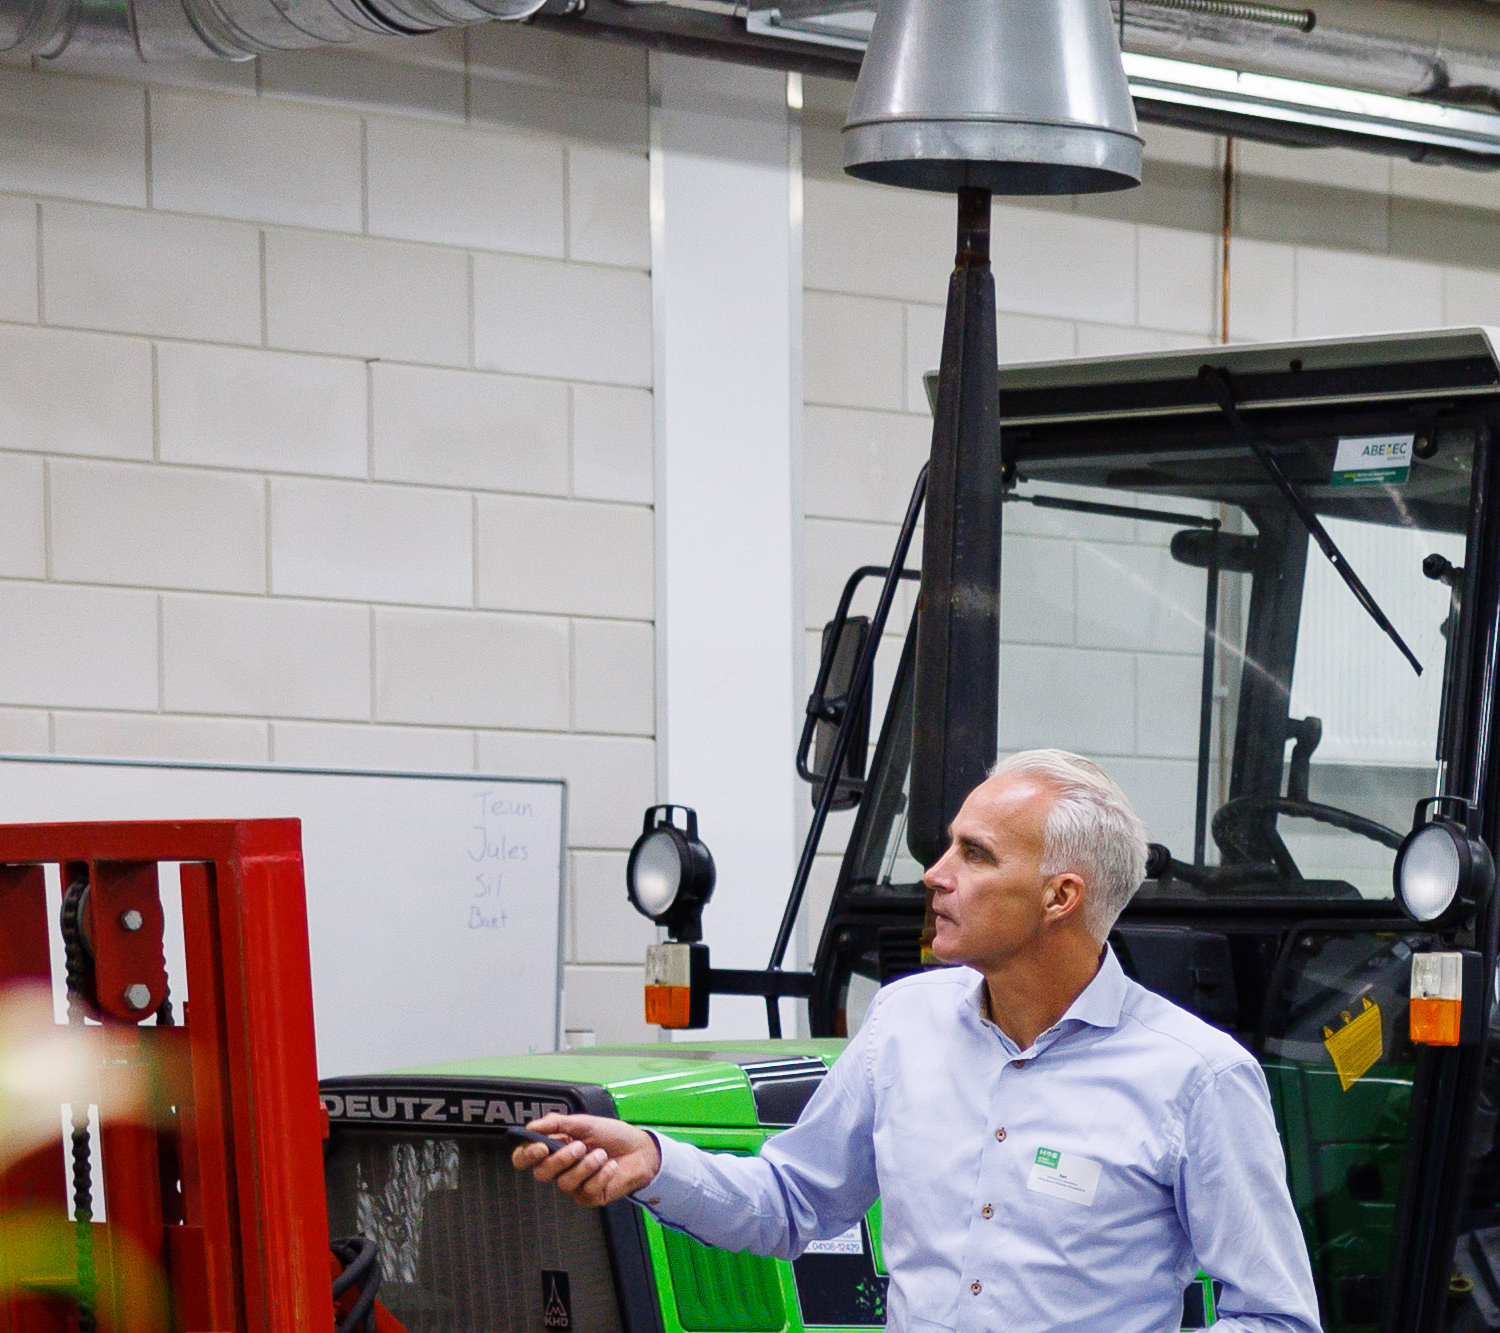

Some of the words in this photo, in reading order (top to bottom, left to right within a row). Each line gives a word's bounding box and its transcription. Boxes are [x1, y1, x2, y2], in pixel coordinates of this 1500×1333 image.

[473, 791, 534, 817] Teun
[467, 826, 530, 863] Jules
[544, 1316, 568, 1327] KHD
